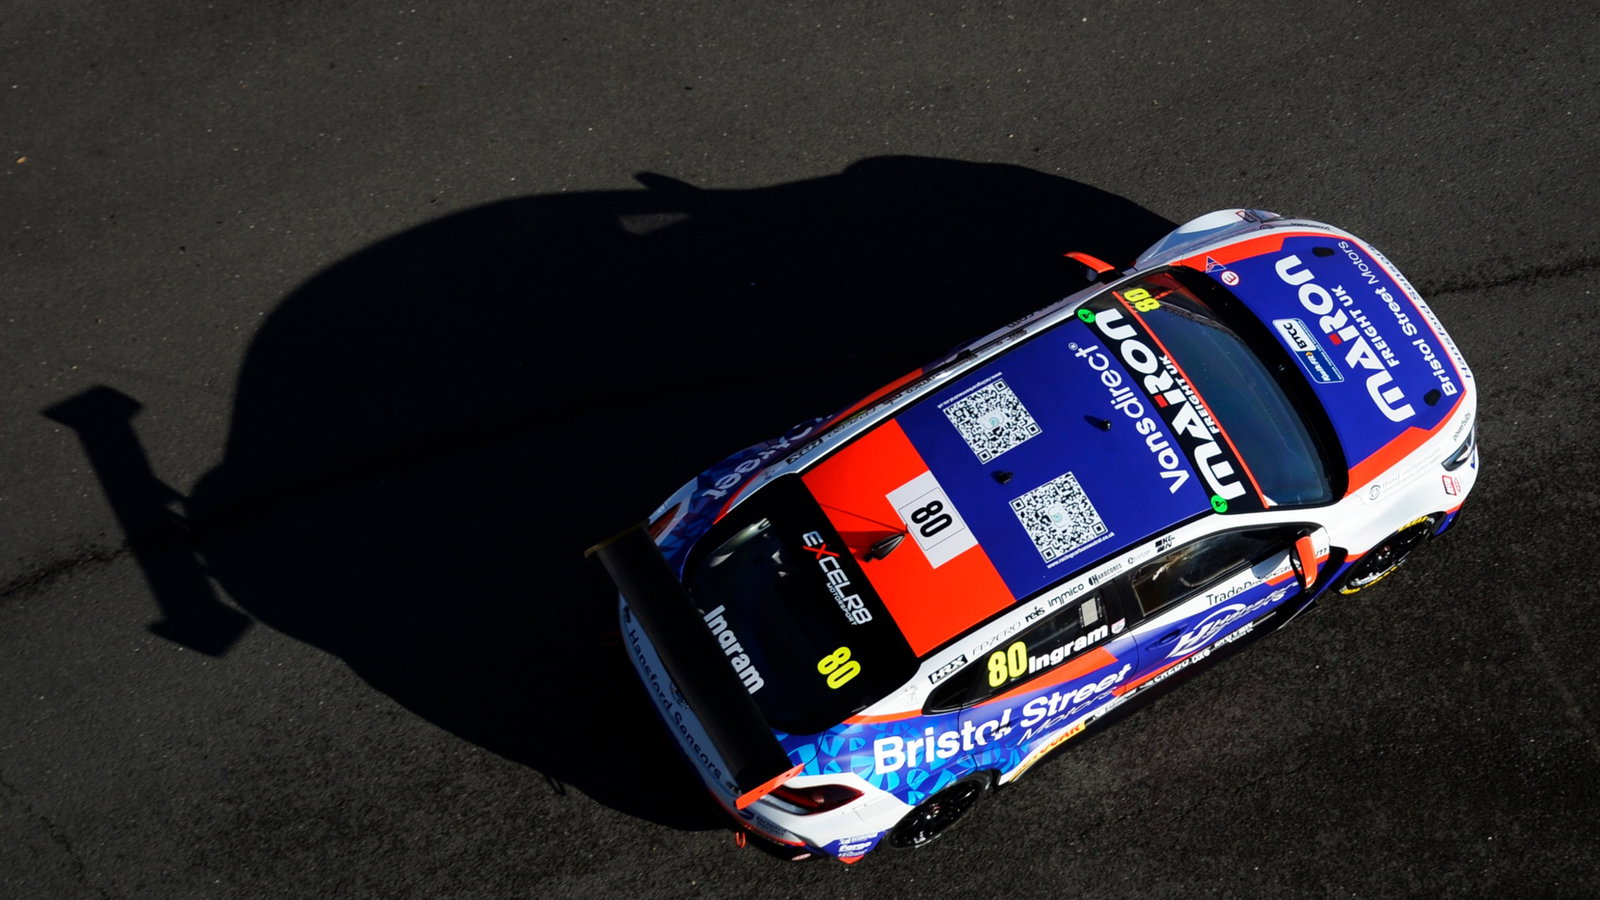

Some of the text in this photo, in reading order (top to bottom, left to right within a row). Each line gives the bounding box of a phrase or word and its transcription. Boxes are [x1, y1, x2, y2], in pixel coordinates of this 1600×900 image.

[1337, 240, 1380, 284] Motors
[1124, 288, 1161, 312] 80
[1331, 284, 1400, 368] FREIGHT UK
[1374, 286, 1418, 338] Street
[1275, 254, 1416, 423] MAIRON
[1283, 322, 1308, 350] BTCC
[1417, 302, 1472, 379] Hansford
[1159, 354, 1220, 434] FREIGHT UK
[1411, 339, 1458, 397] Bristol
[1095, 308, 1246, 500] MAIRON
[910, 500, 953, 539] 80
[802, 530, 873, 625] EXCELR8
[826, 582, 858, 626] MOTORSPORT
[1047, 582, 1085, 607] immico
[1024, 605, 1045, 623] reis
[703, 604, 764, 694] Ingram
[817, 646, 861, 690] 80
[931, 655, 967, 684] HRX
[988, 624, 1109, 688] 80 Ingram
[873, 708, 1013, 775] Bristol
[1020, 663, 1132, 728] Street
[1016, 686, 1119, 746] Motors
